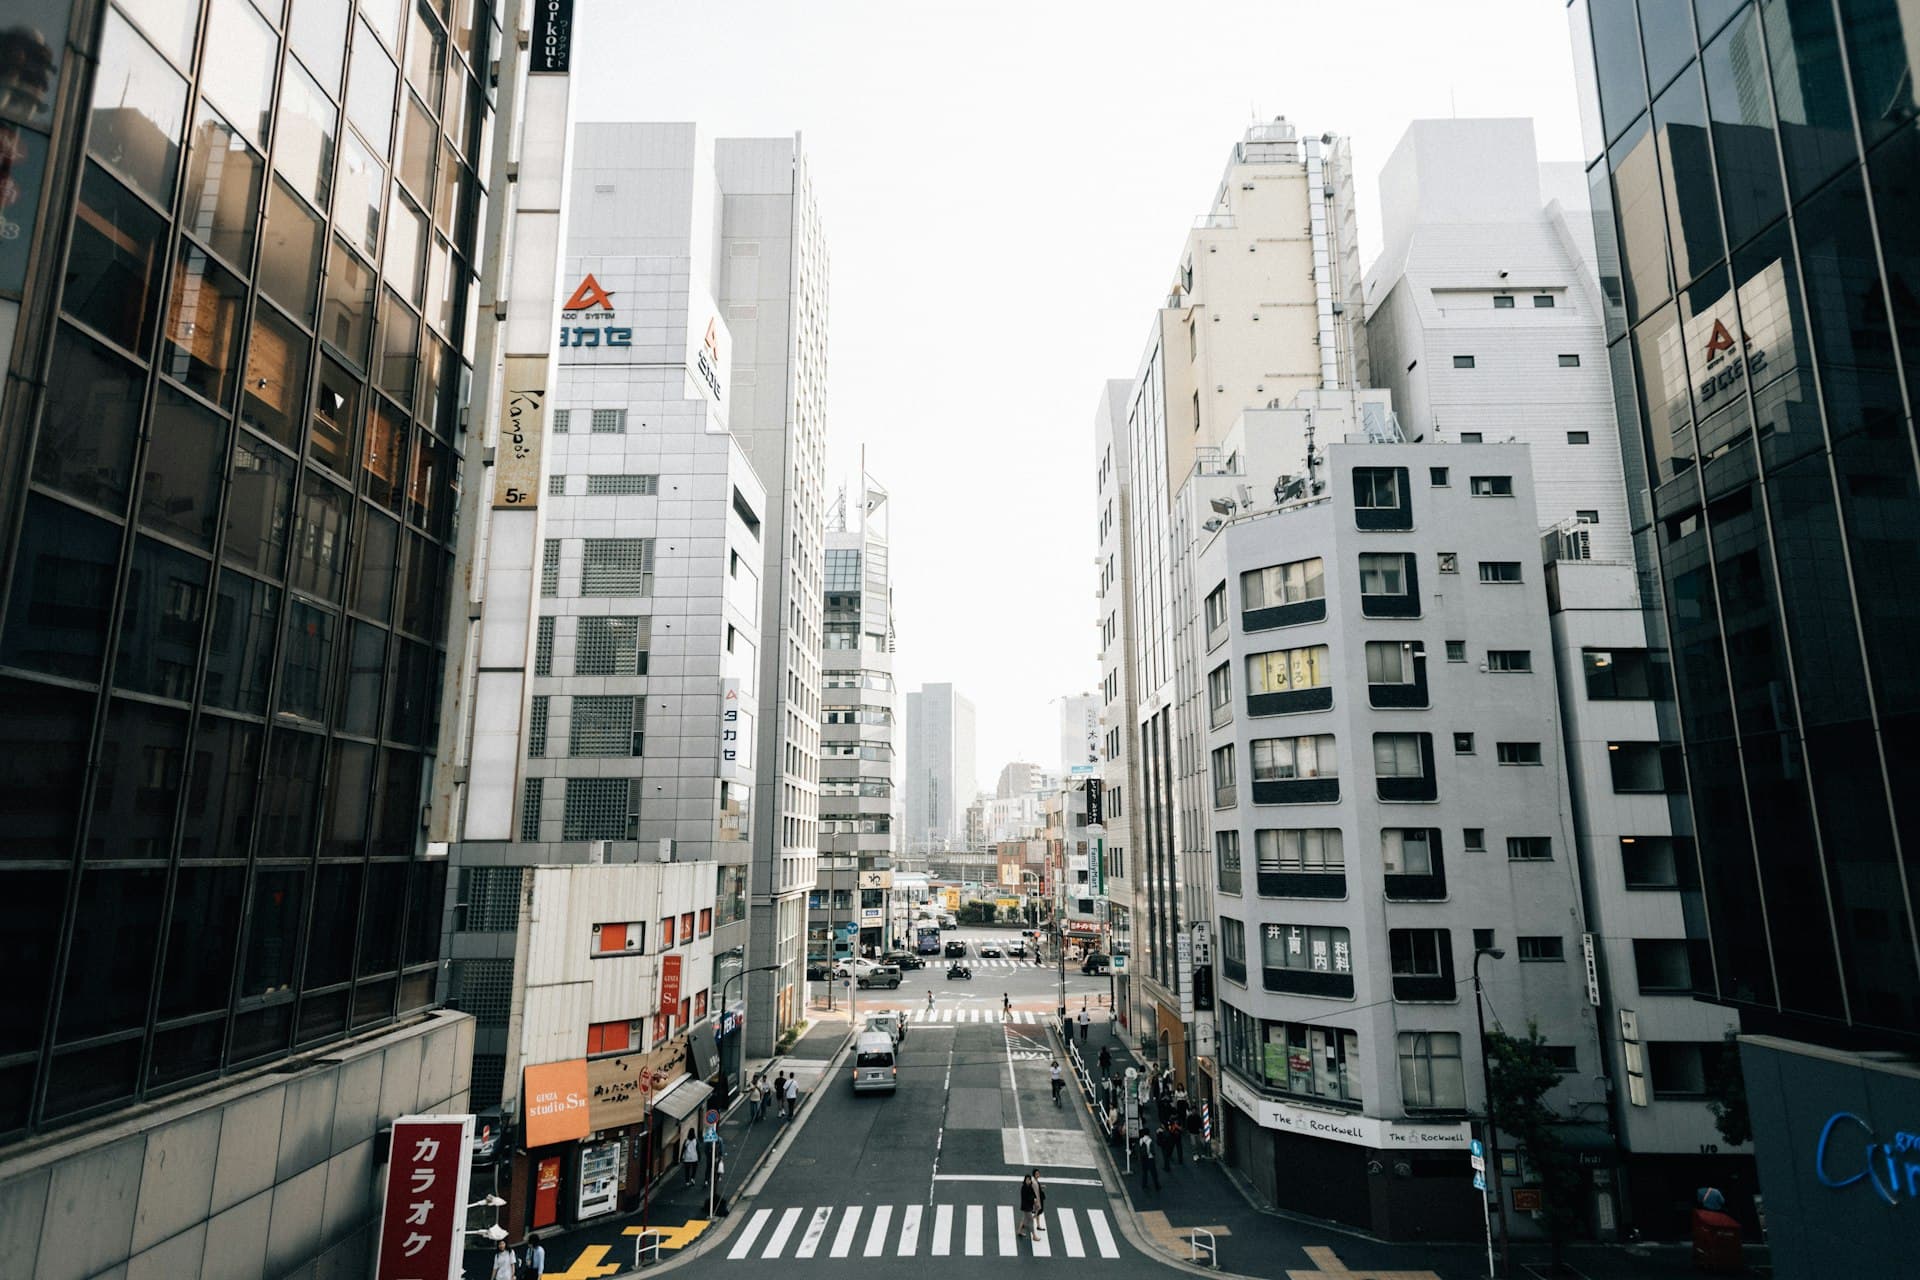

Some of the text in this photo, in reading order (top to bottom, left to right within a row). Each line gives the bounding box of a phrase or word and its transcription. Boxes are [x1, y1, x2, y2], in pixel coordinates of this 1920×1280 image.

[545, 0, 559, 68] orkout
[505, 489, 527, 503] 5F
[723, 710, 737, 760] タカセ
[1091, 847, 1099, 889] FamilyMart
[529, 1101, 565, 1117] studio
[536, 1092, 558, 1102] GINZA
[1272, 1113, 1364, 1138] The Rockwell
[1389, 1132, 1465, 1142] The Rockwell
[402, 1137, 441, 1257] カラオケ
